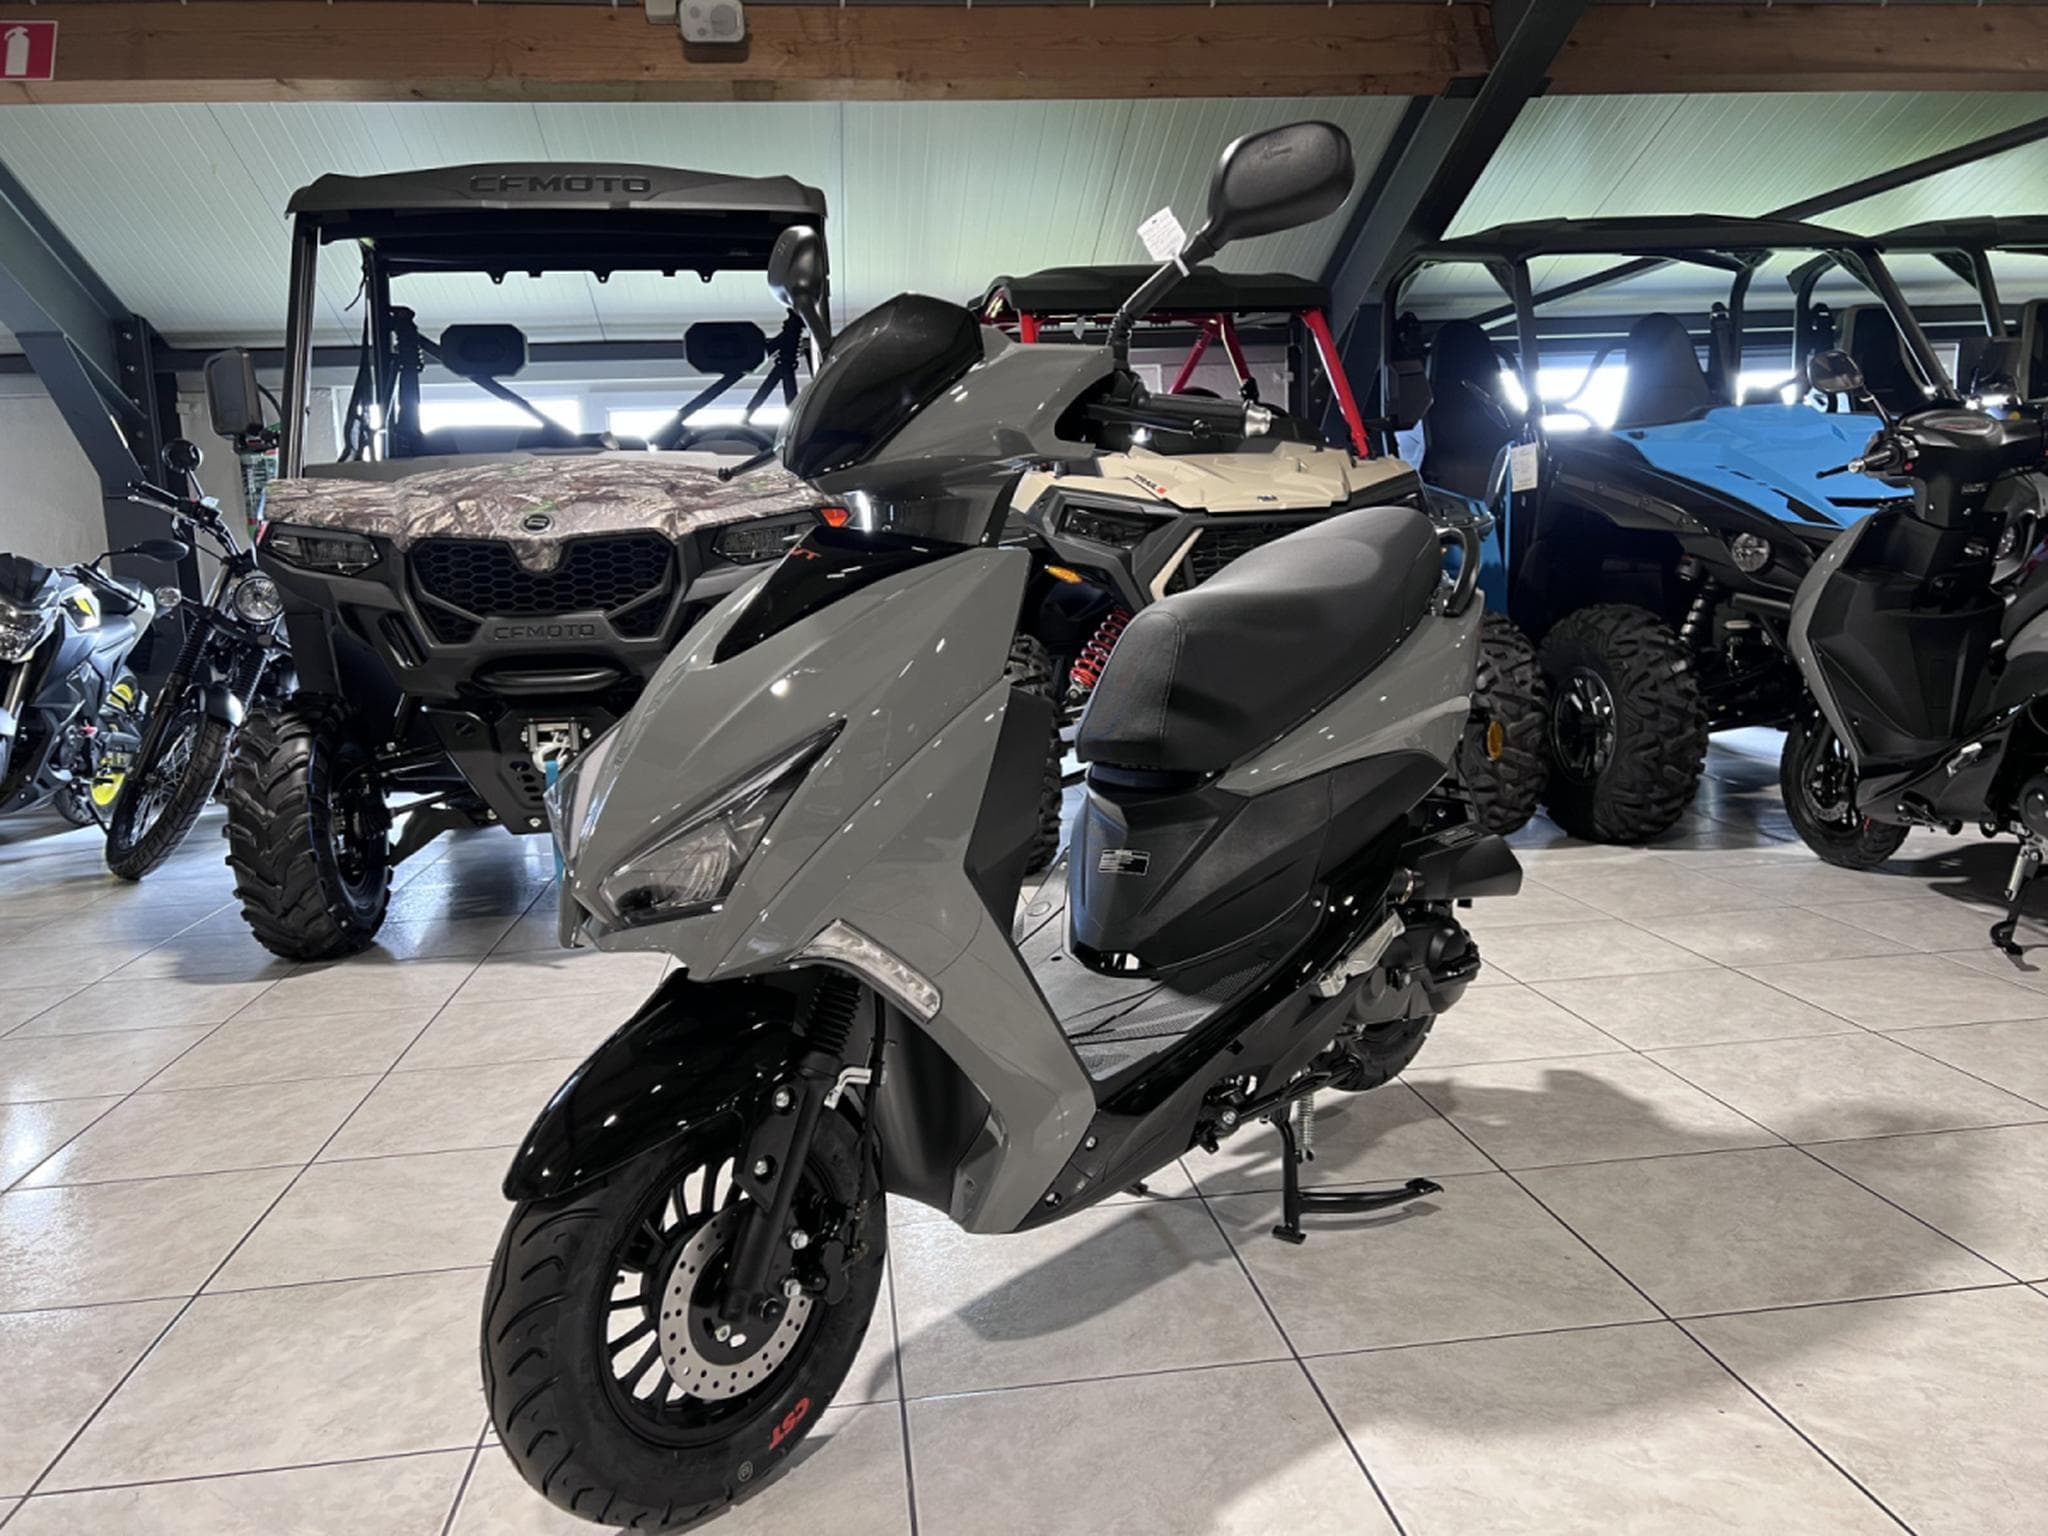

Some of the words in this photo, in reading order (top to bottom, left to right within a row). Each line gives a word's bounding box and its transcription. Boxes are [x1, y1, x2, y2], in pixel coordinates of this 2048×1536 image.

[469, 174, 651, 193] CFMOTO
[494, 623, 595, 640] CFMOTO
[768, 1396, 811, 1450] CST
